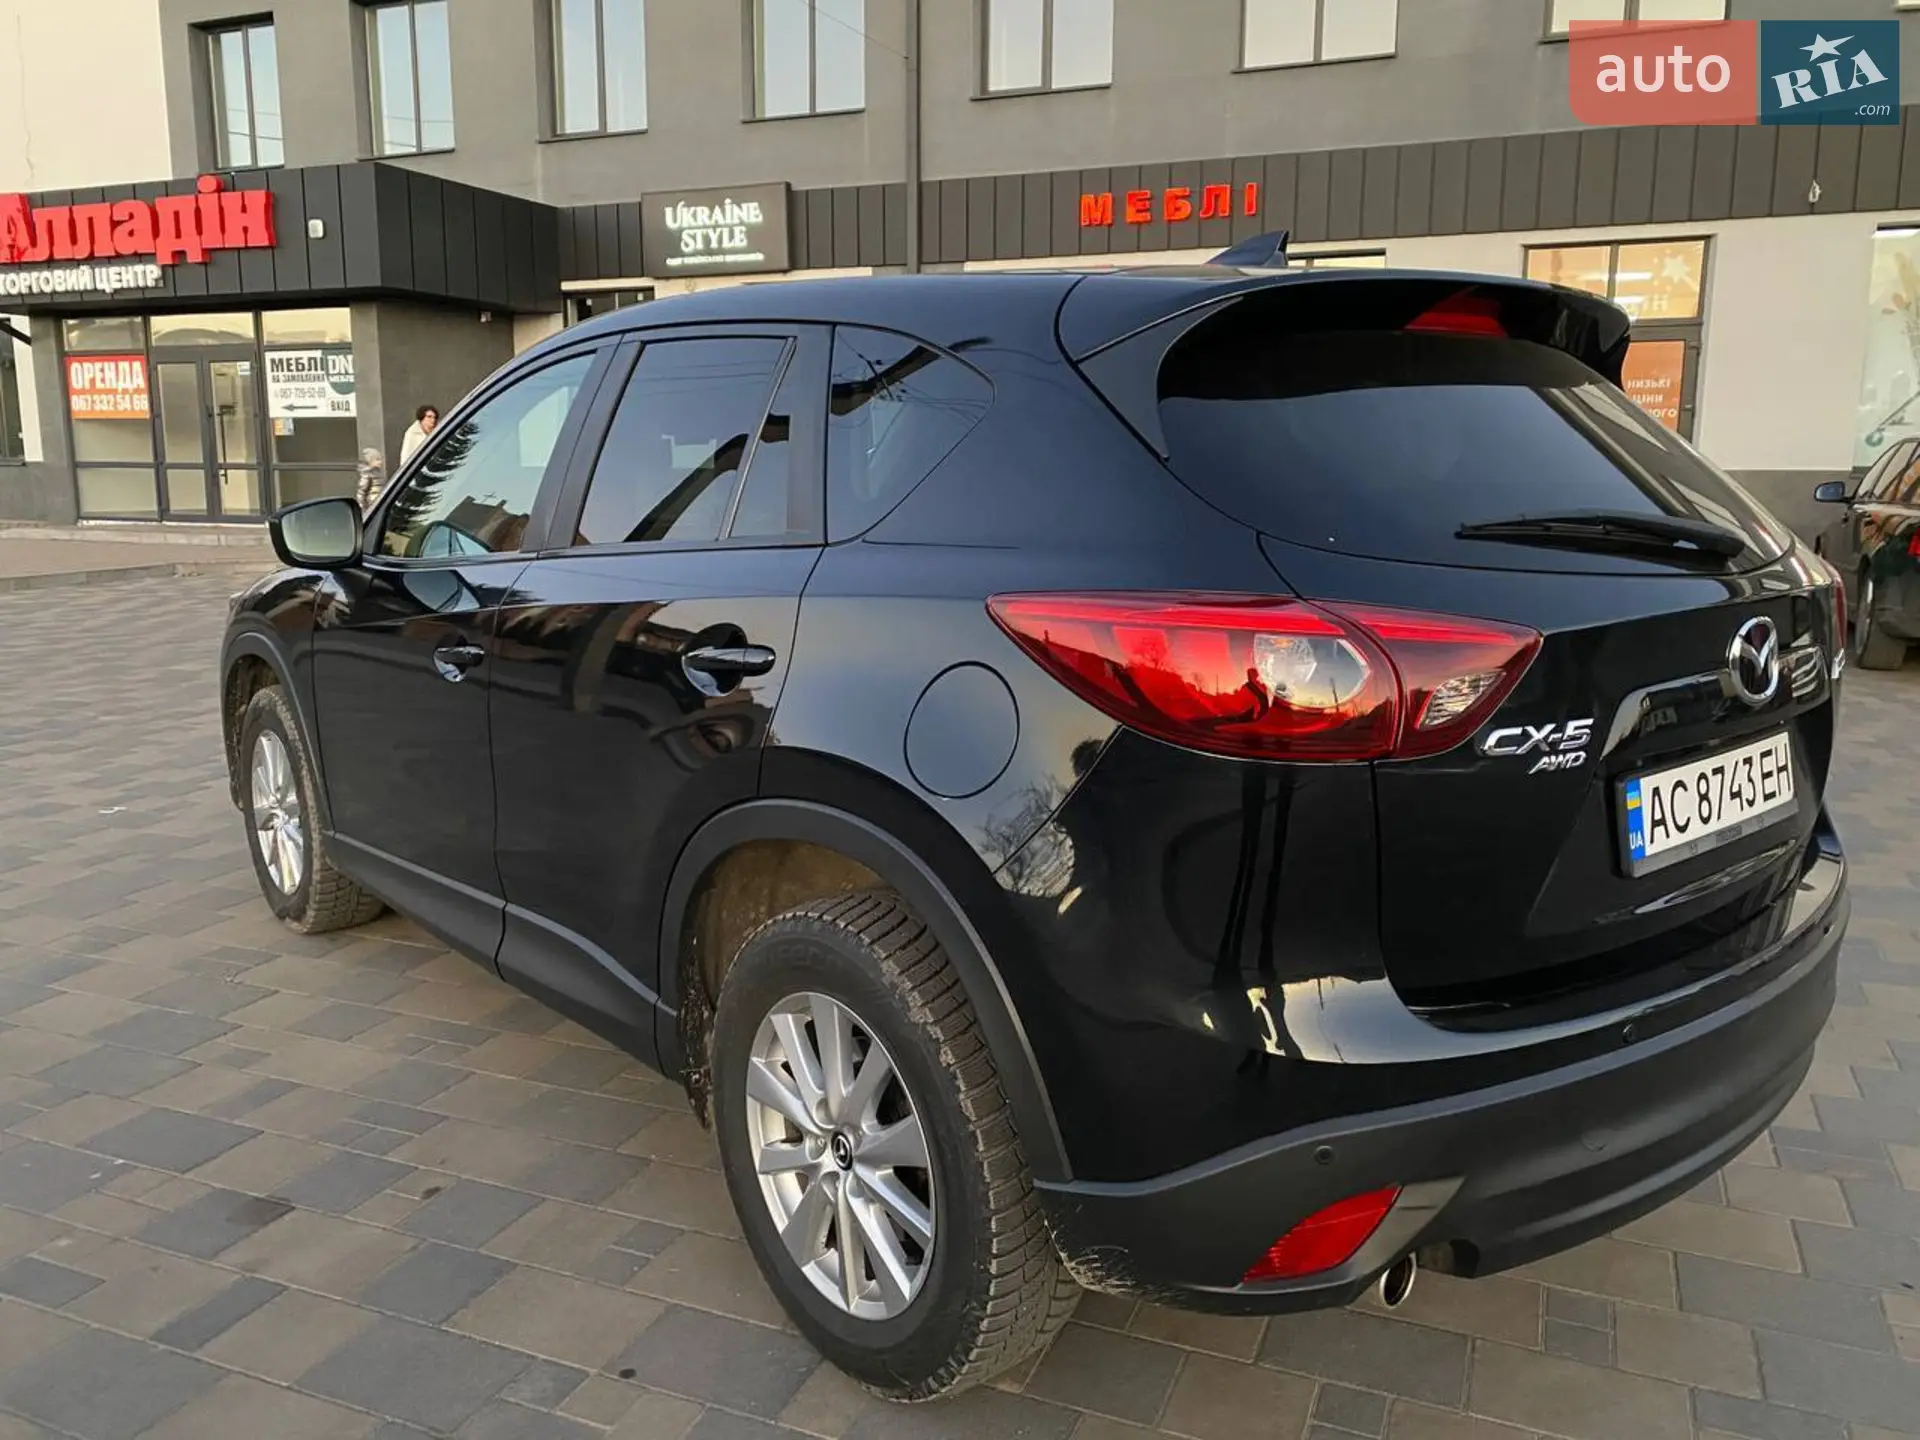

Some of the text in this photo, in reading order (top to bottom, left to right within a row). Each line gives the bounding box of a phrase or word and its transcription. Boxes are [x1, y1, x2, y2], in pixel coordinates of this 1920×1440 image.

[1081, 182, 1257, 227] МЕБЛІ
[681, 226, 748, 253] STYLE
[95, 264, 162, 294] ЦЕНТР
[71, 361, 145, 393] ОРЕНДА
[270, 357, 325, 373] МЕБЛІ
[1484, 718, 1594, 756] CX-5
[1528, 751, 1586, 775] AWD
[1650, 743, 1792, 844] AC 8743 EH
[1629, 832, 1643, 849] UA
